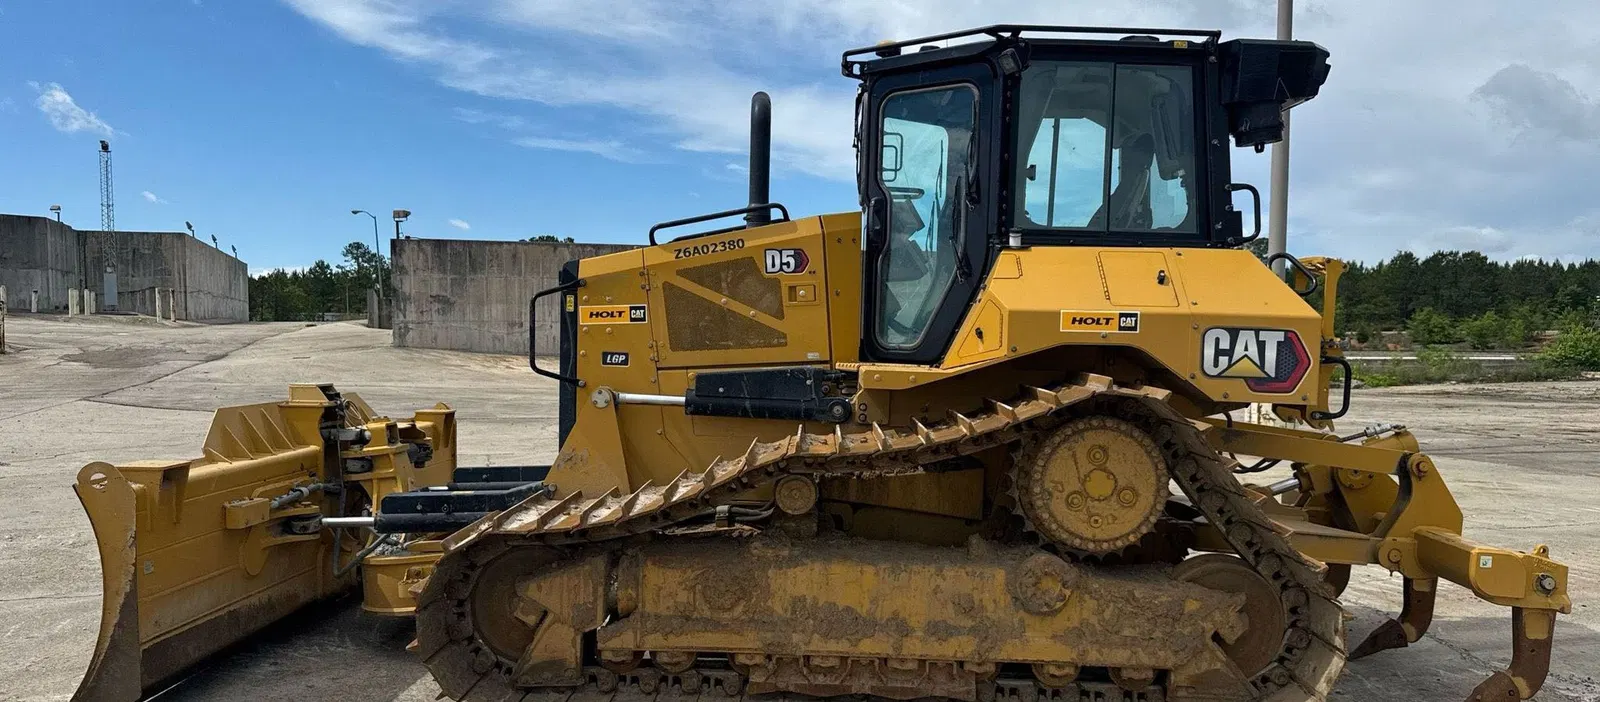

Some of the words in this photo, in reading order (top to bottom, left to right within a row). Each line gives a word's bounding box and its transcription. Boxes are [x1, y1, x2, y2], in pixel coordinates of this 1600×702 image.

[674, 238, 745, 259] Z6A02380
[765, 249, 795, 273] D5
[589, 310, 625, 319] HOLT
[630, 309, 645, 319] CAT
[1071, 316, 1115, 326] HOLT
[1120, 316, 1137, 327] CAT
[606, 354, 626, 364] LGP
[1203, 328, 1285, 378] CAT
